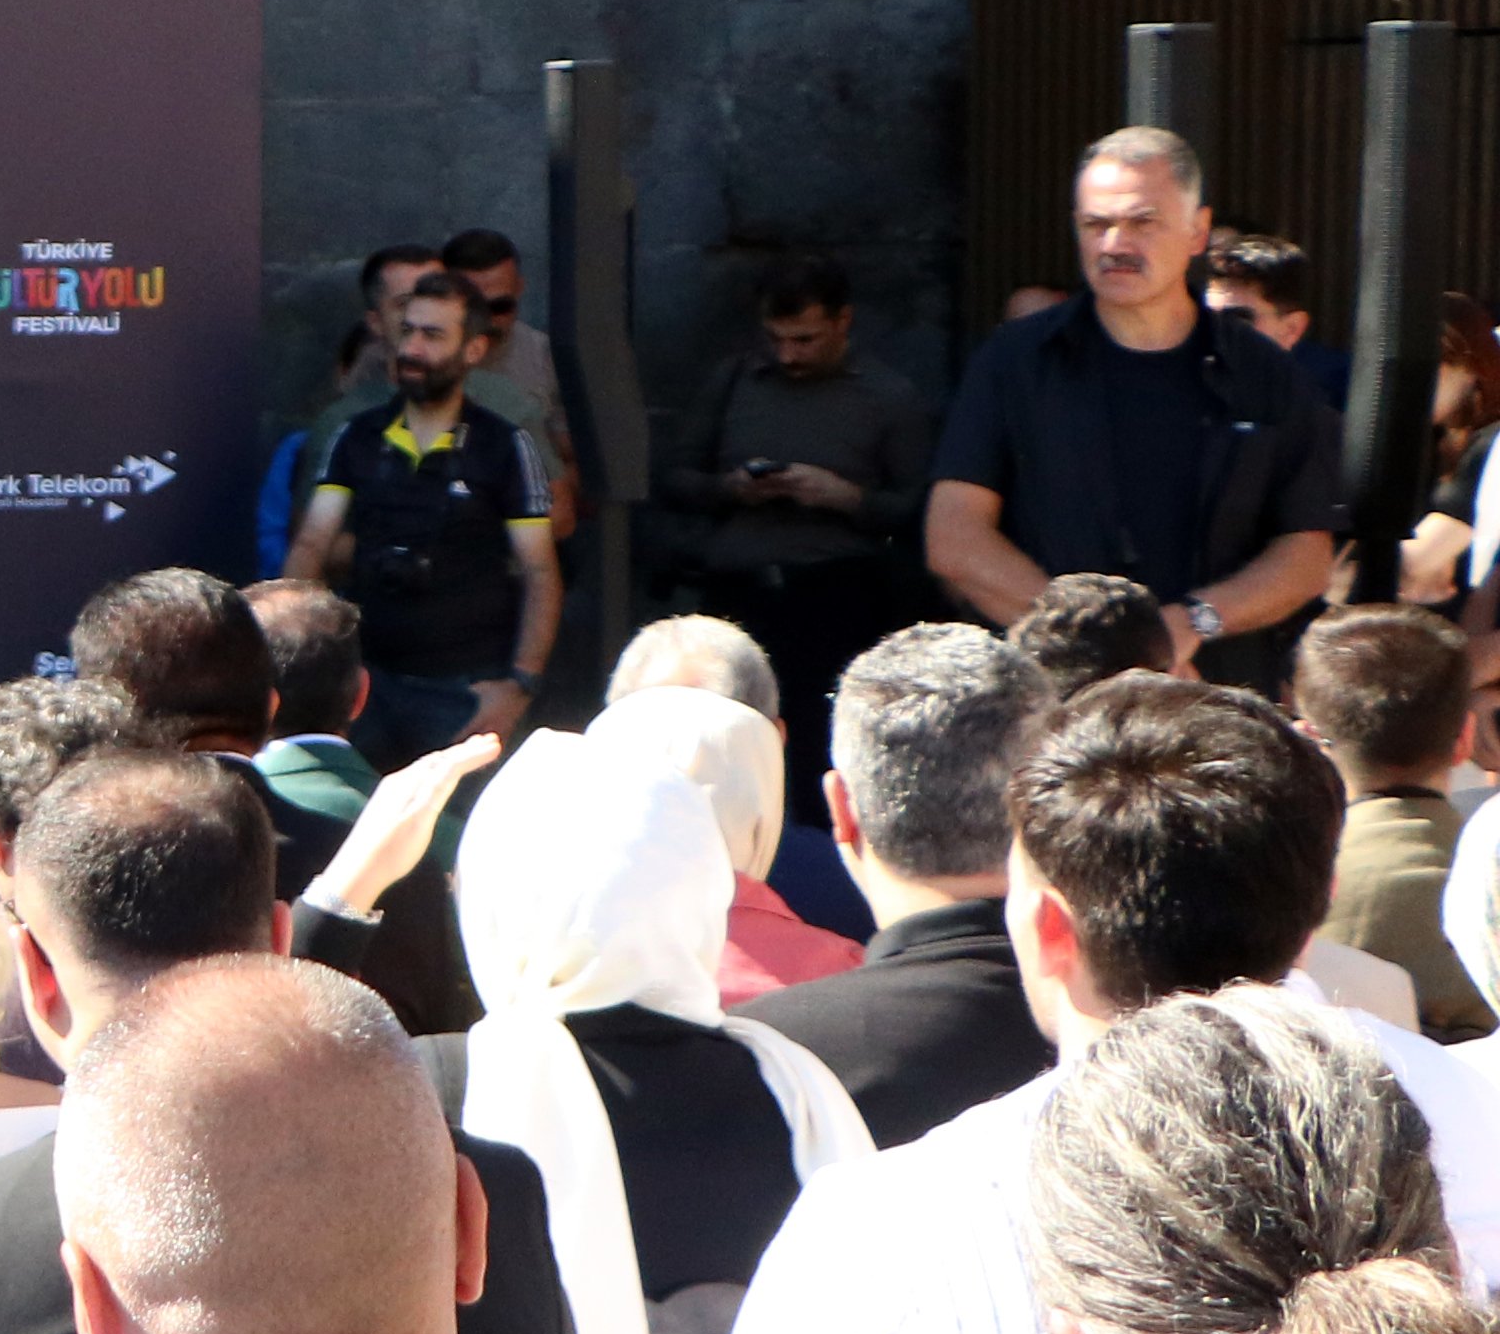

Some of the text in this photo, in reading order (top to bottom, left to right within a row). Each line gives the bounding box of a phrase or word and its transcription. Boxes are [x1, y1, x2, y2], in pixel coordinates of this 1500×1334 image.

[23, 239, 112, 259] TÜRKİYE
[15, 311, 120, 333] FESTİVALİ
[28, 473, 131, 495] Telekom
